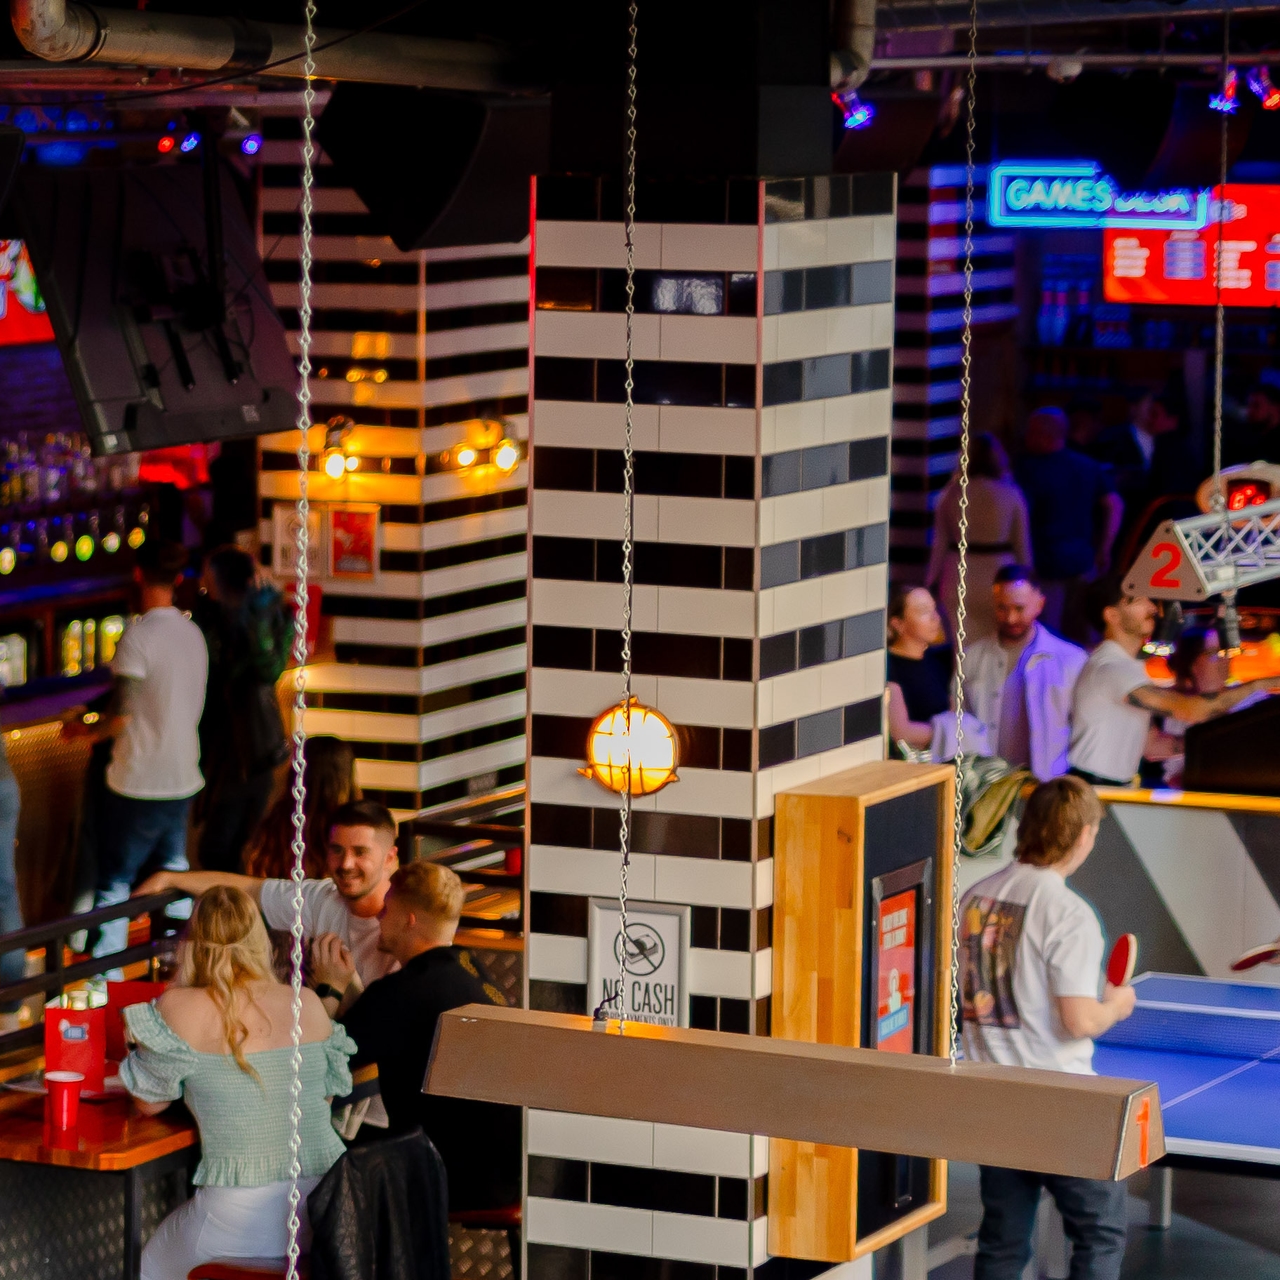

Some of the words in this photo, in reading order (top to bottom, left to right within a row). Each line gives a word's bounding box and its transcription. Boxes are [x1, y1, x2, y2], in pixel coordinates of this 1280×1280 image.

[1006, 179, 1113, 212] GAMES
[1149, 541, 1184, 589] 2
[602, 978, 622, 1010] NO
[631, 981, 675, 1015] CASH
[622, 1013, 656, 1024] AYMENTS
[1134, 1097, 1151, 1168] 1
